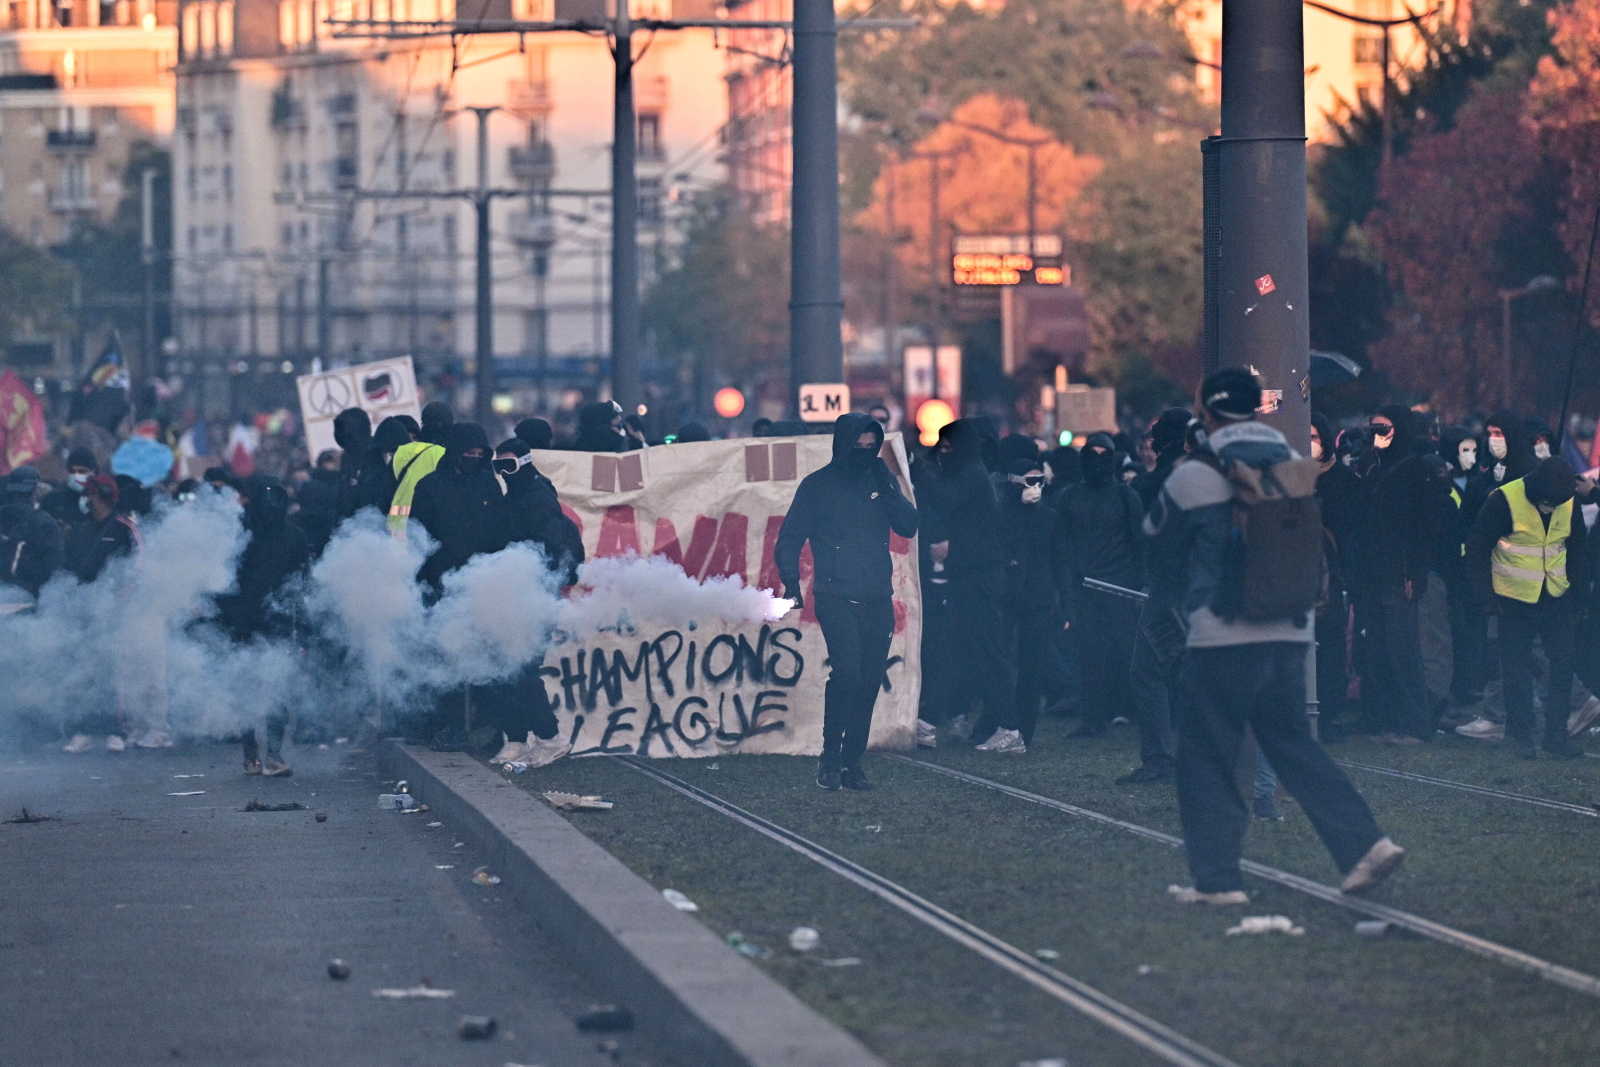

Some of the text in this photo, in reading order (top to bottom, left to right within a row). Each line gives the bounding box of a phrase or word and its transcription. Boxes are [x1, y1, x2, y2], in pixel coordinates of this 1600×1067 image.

[803, 394, 841, 412] 1 M
[567, 690, 790, 756] LEAGUE
